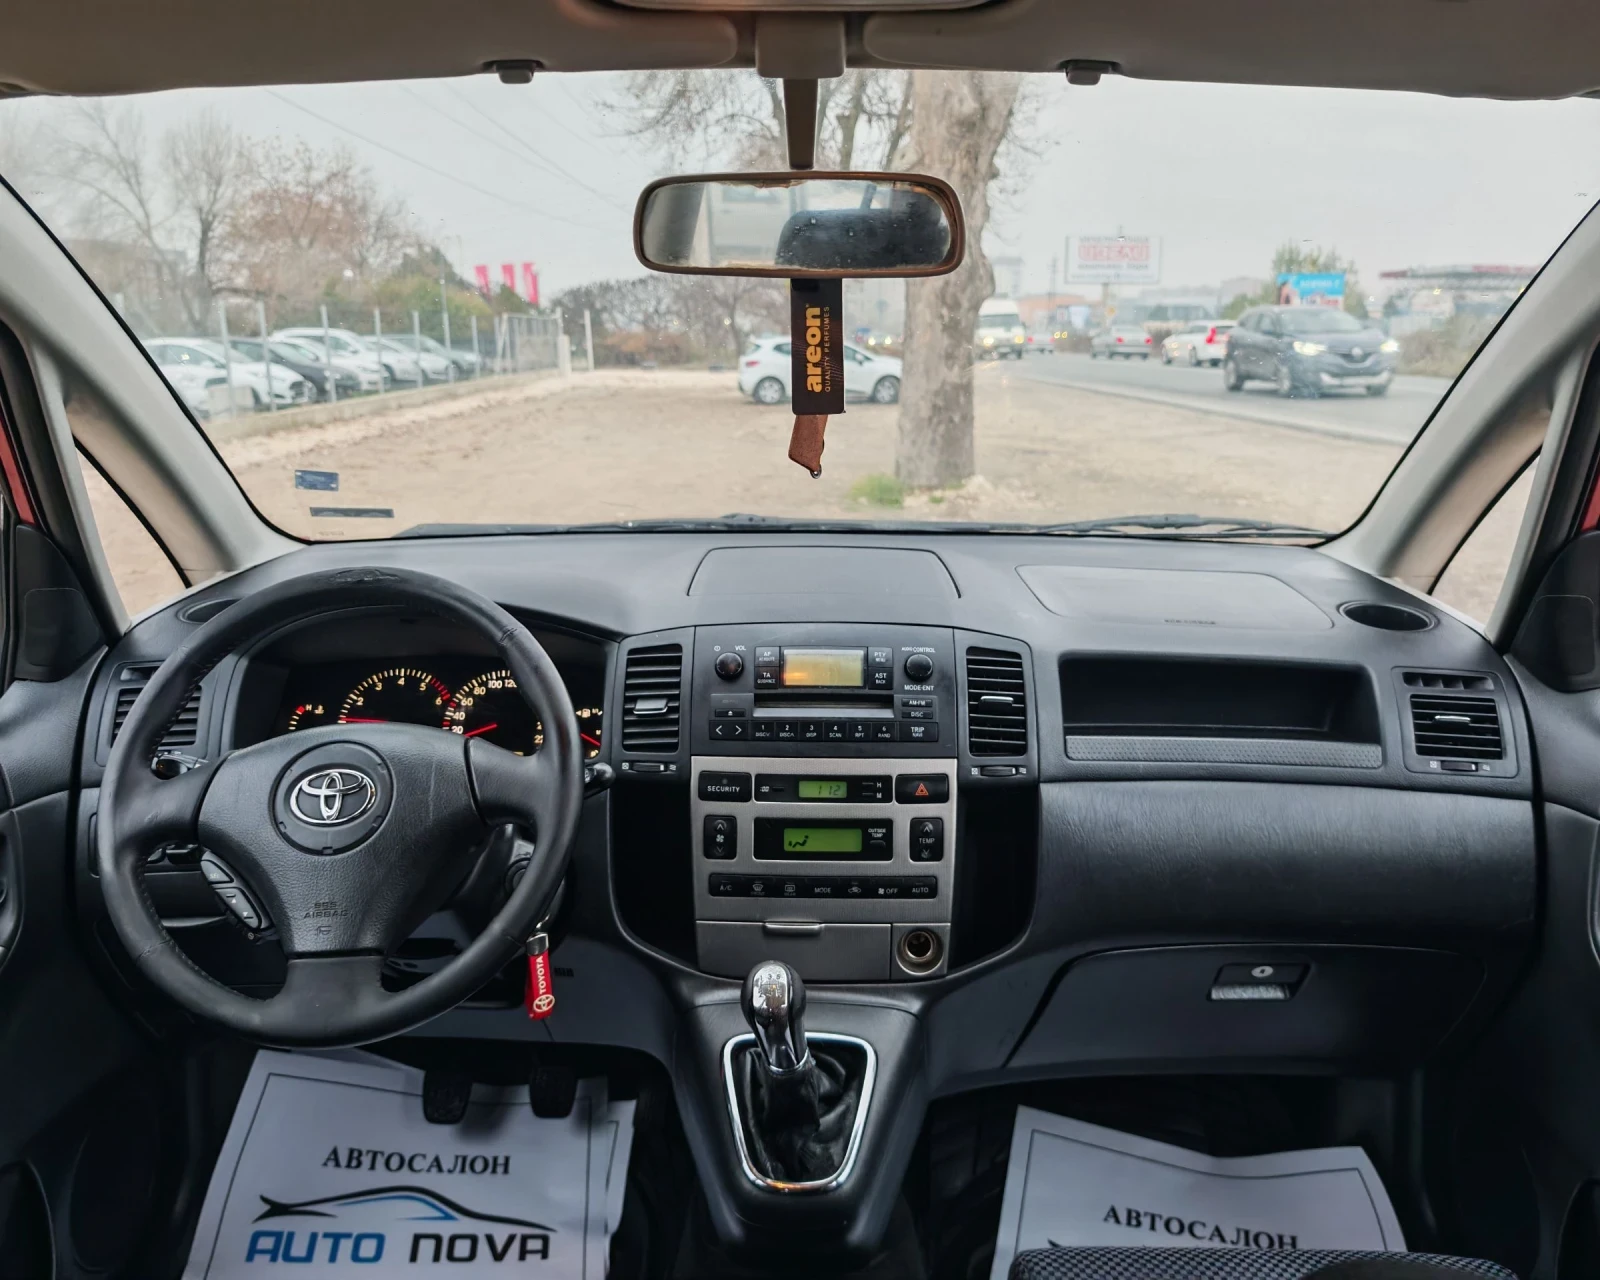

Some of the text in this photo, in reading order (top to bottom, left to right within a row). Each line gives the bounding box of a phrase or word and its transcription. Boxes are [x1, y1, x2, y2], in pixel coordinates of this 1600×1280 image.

[806, 307, 822, 393] areon
[397, 677, 405, 686] 4
[488, 680, 503, 689] 100
[504, 679, 517, 688] 12
[374, 682, 382, 691] 3
[419, 682, 427, 691] 5
[473, 686, 486, 695] 80
[356, 696, 364, 706] 2
[435, 696, 442, 705] 6
[461, 697, 473, 706] 60
[453, 712, 465, 720] 40
[452, 725, 463, 734] 20
[304, 910, 349, 919] AIRBAG
[536, 956, 546, 994] TOYOTA
[322, 1146, 511, 1176] АВТОСАЛОН
[1103, 1204, 1299, 1250] АВТОСАЛОН
[245, 1230, 550, 1263] AUTO NOVA
